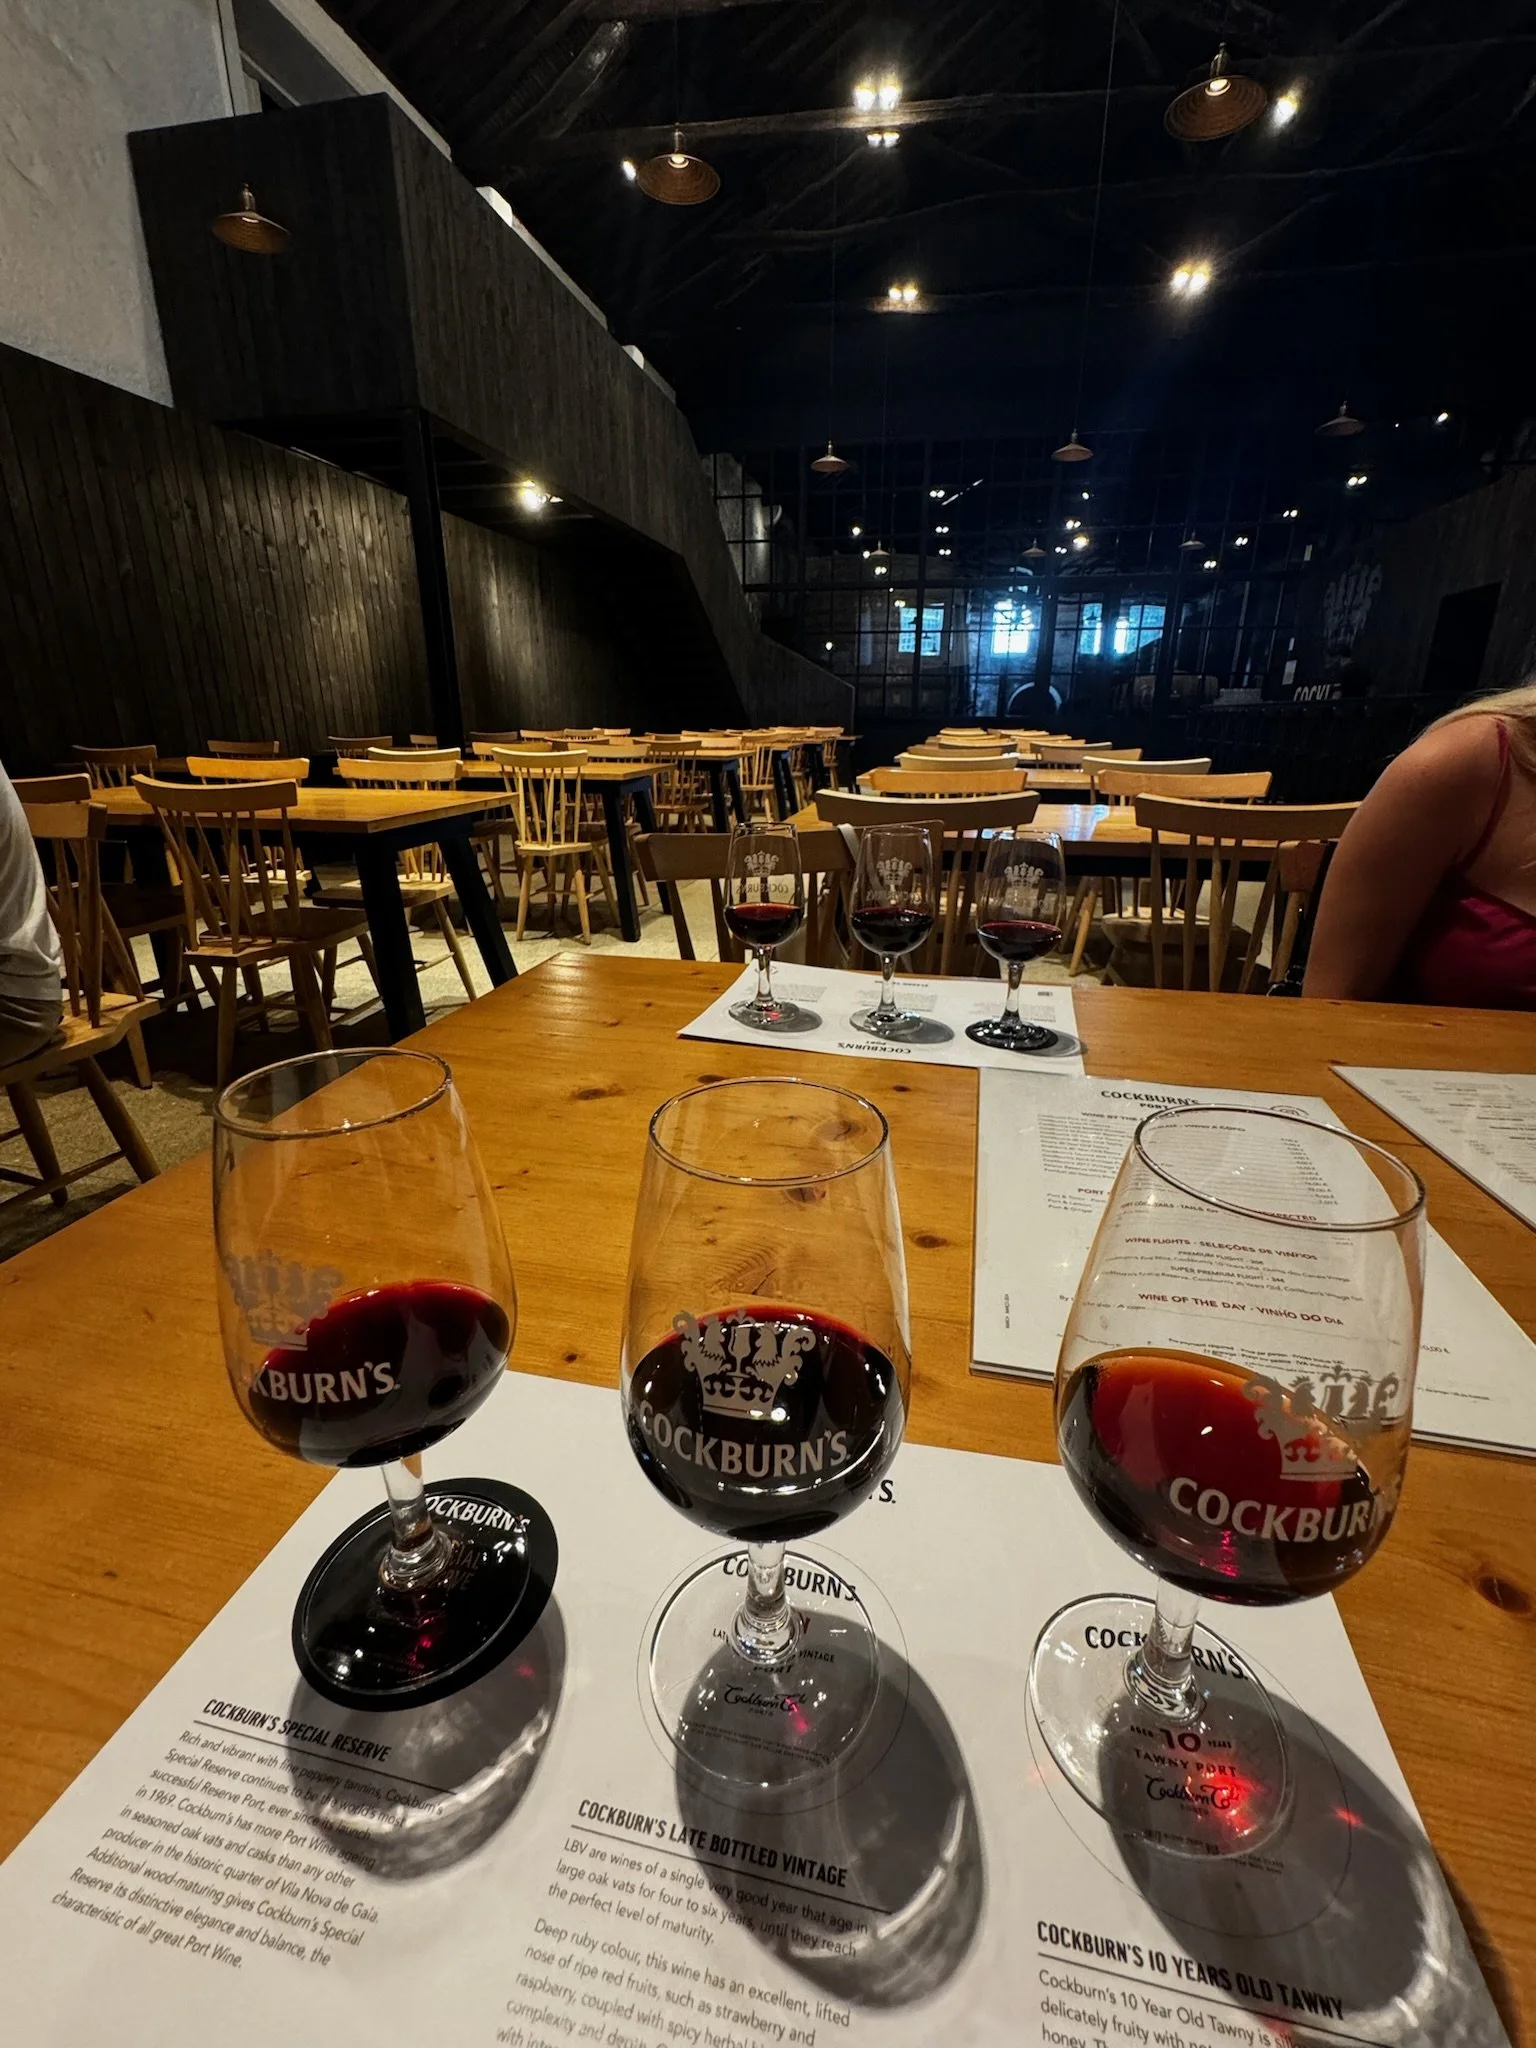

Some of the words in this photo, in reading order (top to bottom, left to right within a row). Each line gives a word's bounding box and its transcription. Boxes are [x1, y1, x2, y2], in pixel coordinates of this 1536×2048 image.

[1138, 1293, 1168, 1302] WINE
[1171, 1294, 1189, 1304] OF
[1191, 1297, 1219, 1308] THE
[1221, 1301, 1247, 1312] DAY
[1256, 1306, 1298, 1320] VINHO
[1300, 1311, 1322, 1323] DO
[1323, 1315, 1345, 1327] DIA
[203, 1699, 280, 1731] COCKBURN'S
[277, 1720, 330, 1746] SPECIAL
[331, 1734, 392, 1762] RESERVE
[1134, 1748, 1189, 1770] TAWNY
[1195, 1762, 1236, 1778] PORT
[1159, 1727, 1201, 1753] 10
[150, 1770, 204, 1791] successful
[200, 1781, 241, 1803] Reserve
[241, 1793, 265, 1812] Port,
[268, 1804, 292, 1817] ever
[165, 1748, 204, 1767] Special
[201, 1758, 241, 1780] Reserve
[241, 1773, 289, 1794] continues
[179, 1730, 201, 1746] Rich
[200, 1740, 224, 1752] and
[221, 1744, 257, 1762] vibrant
[256, 1756, 278, 1768] with
[278, 1759, 299, 1774] fine
[385, 1788, 444, 1816] Cockburn's
[120, 1804, 132, 1818] in
[131, 1811, 184, 1834] seasoned
[180, 1826, 202, 1840] oak
[202, 1833, 225, 1848] vats
[224, 1840, 250, 1855] and
[246, 1847, 277, 1864] casks
[277, 1853, 302, 1871] than
[302, 1864, 325, 1881] any
[324, 1869, 356, 1887] other
[135, 1785, 148, 1798] in
[149, 1789, 177, 1805] 1969.
[177, 1797, 234, 1825] Cockburn's
[233, 1814, 254, 1831] has
[253, 1824, 282, 1840] more
[283, 1829, 307, 1847] Port
[308, 1836, 336, 1853] Wine
[578, 1799, 667, 1838] COCKBURN'S
[669, 1823, 705, 1849] LATE
[709, 1834, 777, 1868] BOTTLED
[783, 1853, 847, 1888] VINTAGE
[86, 1846, 147, 1873] Additional
[143, 1868, 225, 1906] wood-maturing
[222, 1893, 256, 1911] gives
[257, 1900, 319, 1933] Cockburn's
[319, 1920, 365, 1945] Special
[101, 1828, 153, 1849] producer
[164, 1845, 184, 1861] the
[183, 1849, 224, 1874] historic
[223, 1866, 265, 1885] quarter
[280, 1879, 300, 1898] Vila
[300, 1887, 332, 1908] Nova
[351, 1902, 378, 1923] Gaia.
[548, 1882, 568, 1899] the
[568, 1892, 613, 1913] perfect
[615, 1900, 645, 1921] level
[661, 1919, 714, 1946] maturity.
[556, 1859, 586, 1881] large
[588, 1872, 609, 1886] oak
[613, 1879, 636, 1894] vats
[638, 1882, 656, 1899] for
[659, 1887, 683, 1906] four
[702, 1902, 718, 1918] six
[719, 1910, 755, 1931] years,
[760, 1922, 789, 1938] until
[791, 1928, 819, 1950] they
[822, 1939, 856, 1957] reach
[564, 1838, 589, 1854] LBV
[589, 1848, 607, 1862] are
[610, 1853, 642, 1871] wines
[670, 1869, 705, 1890] single
[709, 1882, 733, 1900] very
[735, 1890, 770, 1907] good
[770, 1899, 798, 1914] year
[802, 1904, 826, 1923] that
[829, 1915, 853, 1932] age
[52, 1890, 124, 1926] characteristic
[138, 1918, 158, 1935] all
[149, 1928, 185, 1948] great
[183, 1935, 211, 1956] Port
[211, 1943, 242, 1968] Wine.
[70, 1867, 114, 1893] Reserve
[113, 1882, 129, 1898] its
[127, 1887, 184, 1917] distinctive
[184, 1906, 236, 1934] elegance
[235, 1926, 263, 1942] and
[259, 1929, 305, 1960] balance,
[310, 1946, 331, 1966] the
[525, 1946, 555, 1964] nose
[573, 1959, 598, 1979] ripe
[601, 1969, 625, 1986] red
[626, 1972, 660, 2001] fruits,
[666, 1990, 694, 2009] such
[715, 2005, 786, 2042] strawberry
[789, 2028, 816, 2047] and
[534, 1918, 568, 1943] Deep
[570, 1932, 599, 1953] ruby
[601, 1941, 641, 1966] colour,
[645, 1951, 668, 1972] this
[671, 1961, 700, 1982] wine
[703, 1967, 726, 1989] has
[748, 1987, 810, 2018] excellent,
[815, 2001, 851, 2027] lifted
[1037, 1921, 1144, 1967] COCKBURN'S
[1149, 1950, 1167, 1973] 10
[1171, 1955, 1233, 1993] YEARS
[1236, 1973, 1273, 2001] OLD
[1276, 1983, 1344, 2021] TAWNY
[1039, 1969, 1116, 2005] Cockburn's
[1121, 1991, 1138, 2010] 10
[1141, 1996, 1172, 2018] Year
[1176, 2006, 1205, 2029] Old
[1207, 2014, 1254, 2047] Tawny
[506, 2000, 576, 2036] complexity
[578, 2023, 606, 2042] and
[581, 1993, 635, 2020] coupled
[637, 2009, 664, 2031] with
[667, 2021, 702, 2046] spicy
[1040, 1996, 1108, 2034] delicately
[1112, 2015, 1149, 2045] fruity
[1153, 2030, 1185, 2048] with
